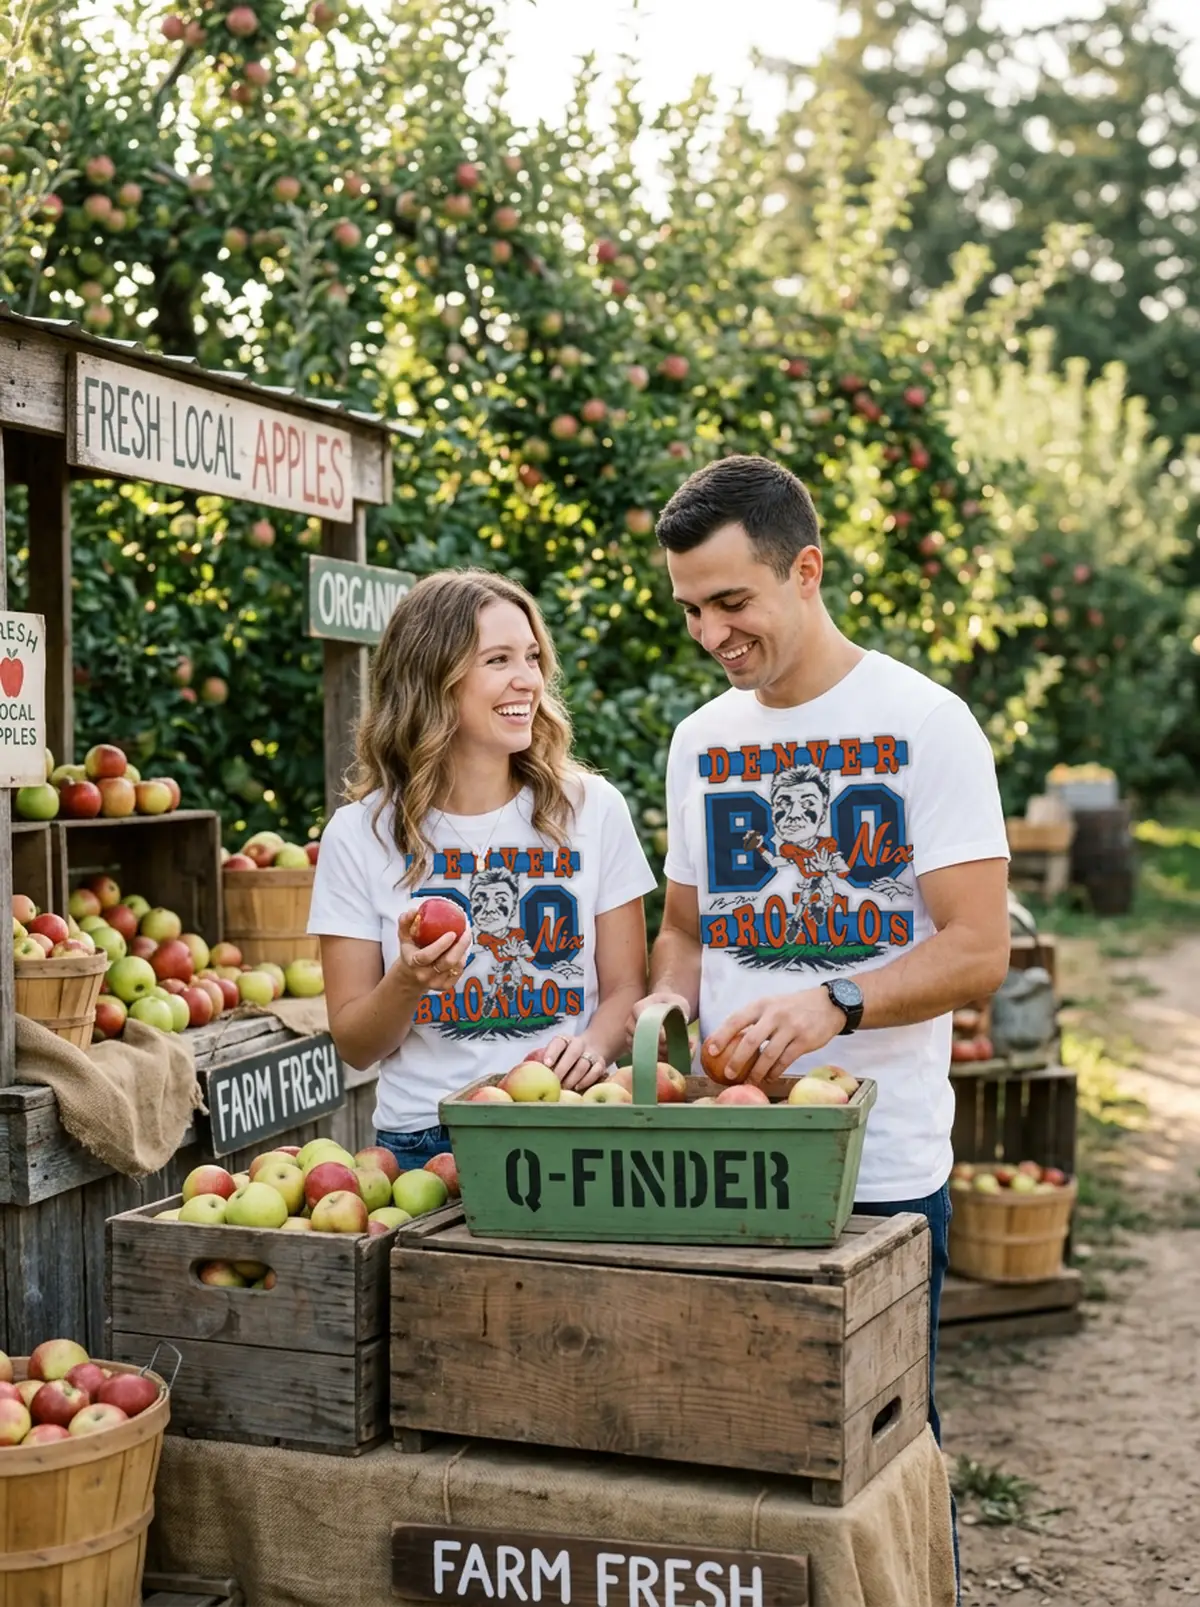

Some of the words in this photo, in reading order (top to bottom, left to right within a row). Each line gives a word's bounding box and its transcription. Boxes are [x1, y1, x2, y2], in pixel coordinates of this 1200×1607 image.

[84, 377, 161, 462] FRESH
[172, 401, 241, 480] LOCAL
[252, 419, 345, 510] APPLES
[0, 620, 38, 653] RESH
[0, 703, 35, 721] OCAL
[706, 735, 900, 783] DENVER
[847, 821, 914, 869] Nix
[533, 915, 584, 953] Nix
[216, 1065, 275, 1142] FARM
[278, 1043, 339, 1118] FRESH
[505, 1148, 790, 1212] Q-FINDER
[433, 1540, 571, 1604] FARM
[596, 1553, 763, 1607] FRESH
